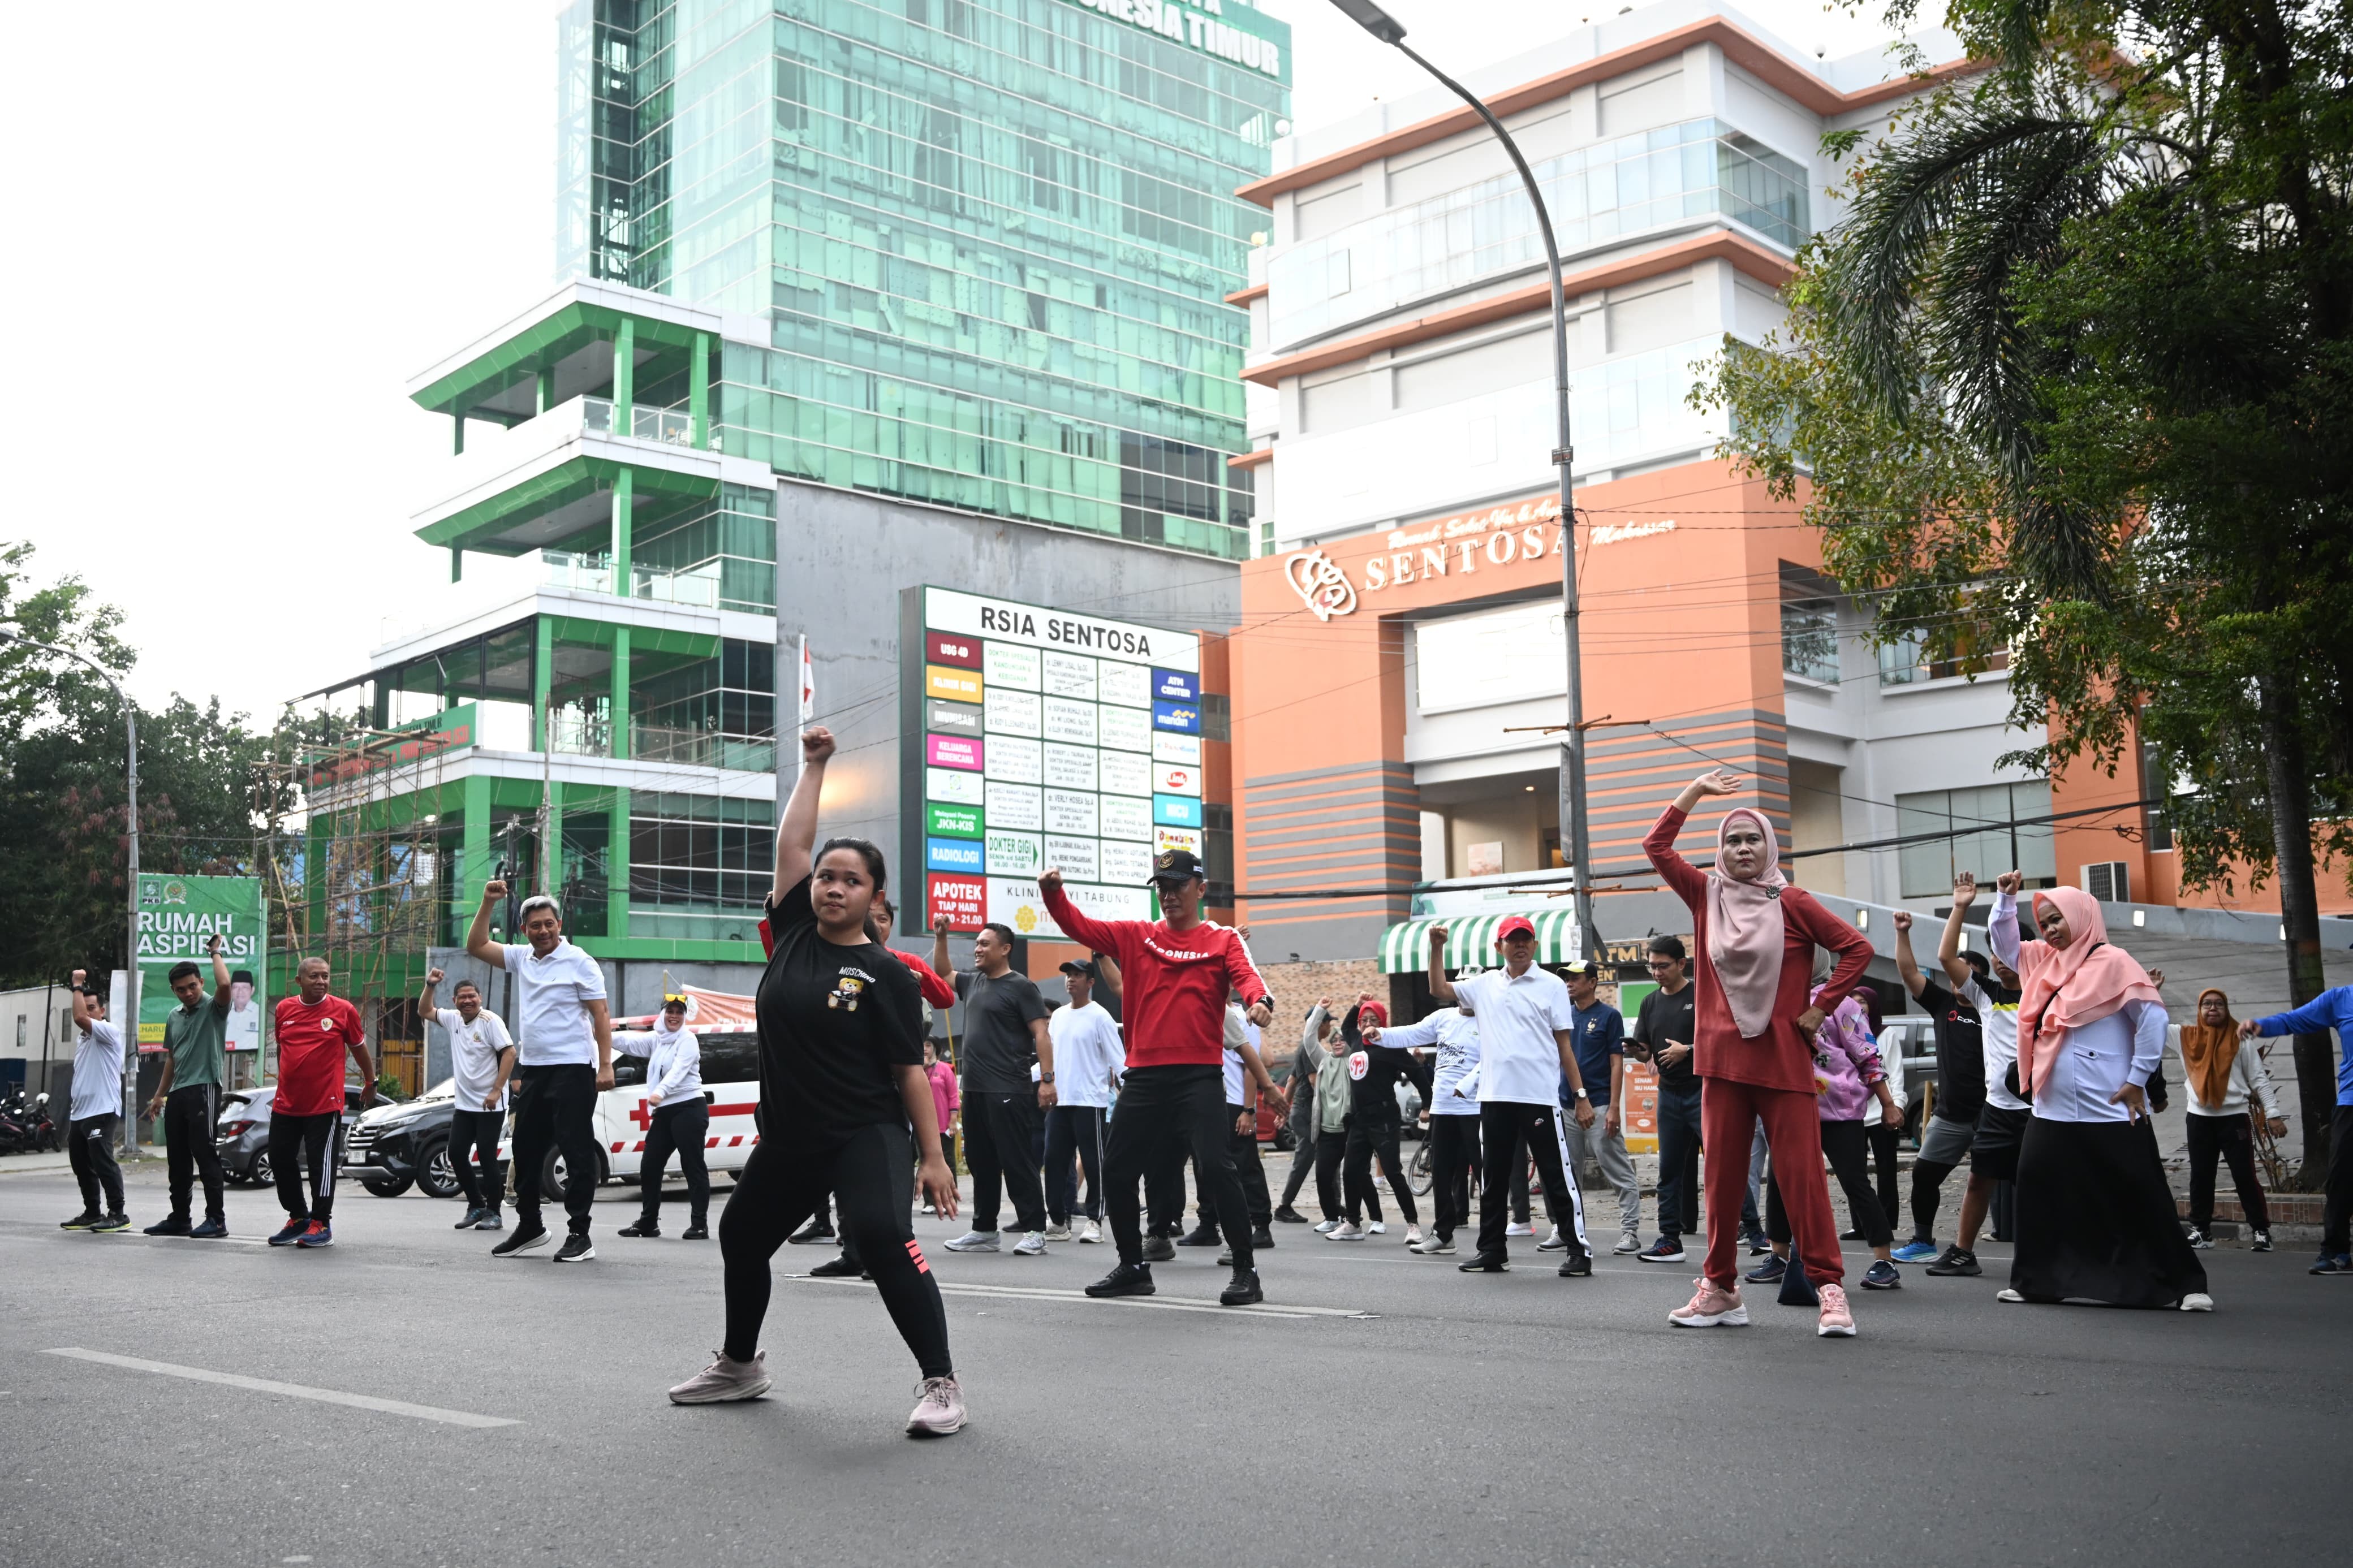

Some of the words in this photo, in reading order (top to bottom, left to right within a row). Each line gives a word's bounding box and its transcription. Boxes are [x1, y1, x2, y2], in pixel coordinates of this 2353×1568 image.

[1076, 0, 1184, 41] NESIA
[1185, 11, 1279, 77] TIMUR
[981, 606, 1036, 637] RSIA
[1048, 619, 1151, 656] SENTOSA
[941, 643, 956, 656] USG
[957, 646, 968, 658] 4D
[960, 681, 976, 692] GIGI
[1168, 676, 1184, 687] ATM
[1161, 685, 1191, 698] CENTER
[938, 741, 972, 753] KELUARGA
[937, 751, 974, 764] BERENCANA
[937, 818, 975, 832] JKN-KIS
[989, 836, 1015, 853] DOKTER
[1018, 839, 1031, 854] GIGI
[932, 848, 979, 864] RADIOLOGI
[933, 882, 982, 900] APOTEK
[1007, 887, 1039, 898] KLINI
[1085, 892, 1130, 904] TABUNG
[937, 901, 956, 911] TIAP
[958, 902, 977, 912] HARI
[137, 912, 232, 933] RUMAH
[962, 914, 982, 925] 21.00
[839, 966, 876, 983] MOSCHINO
